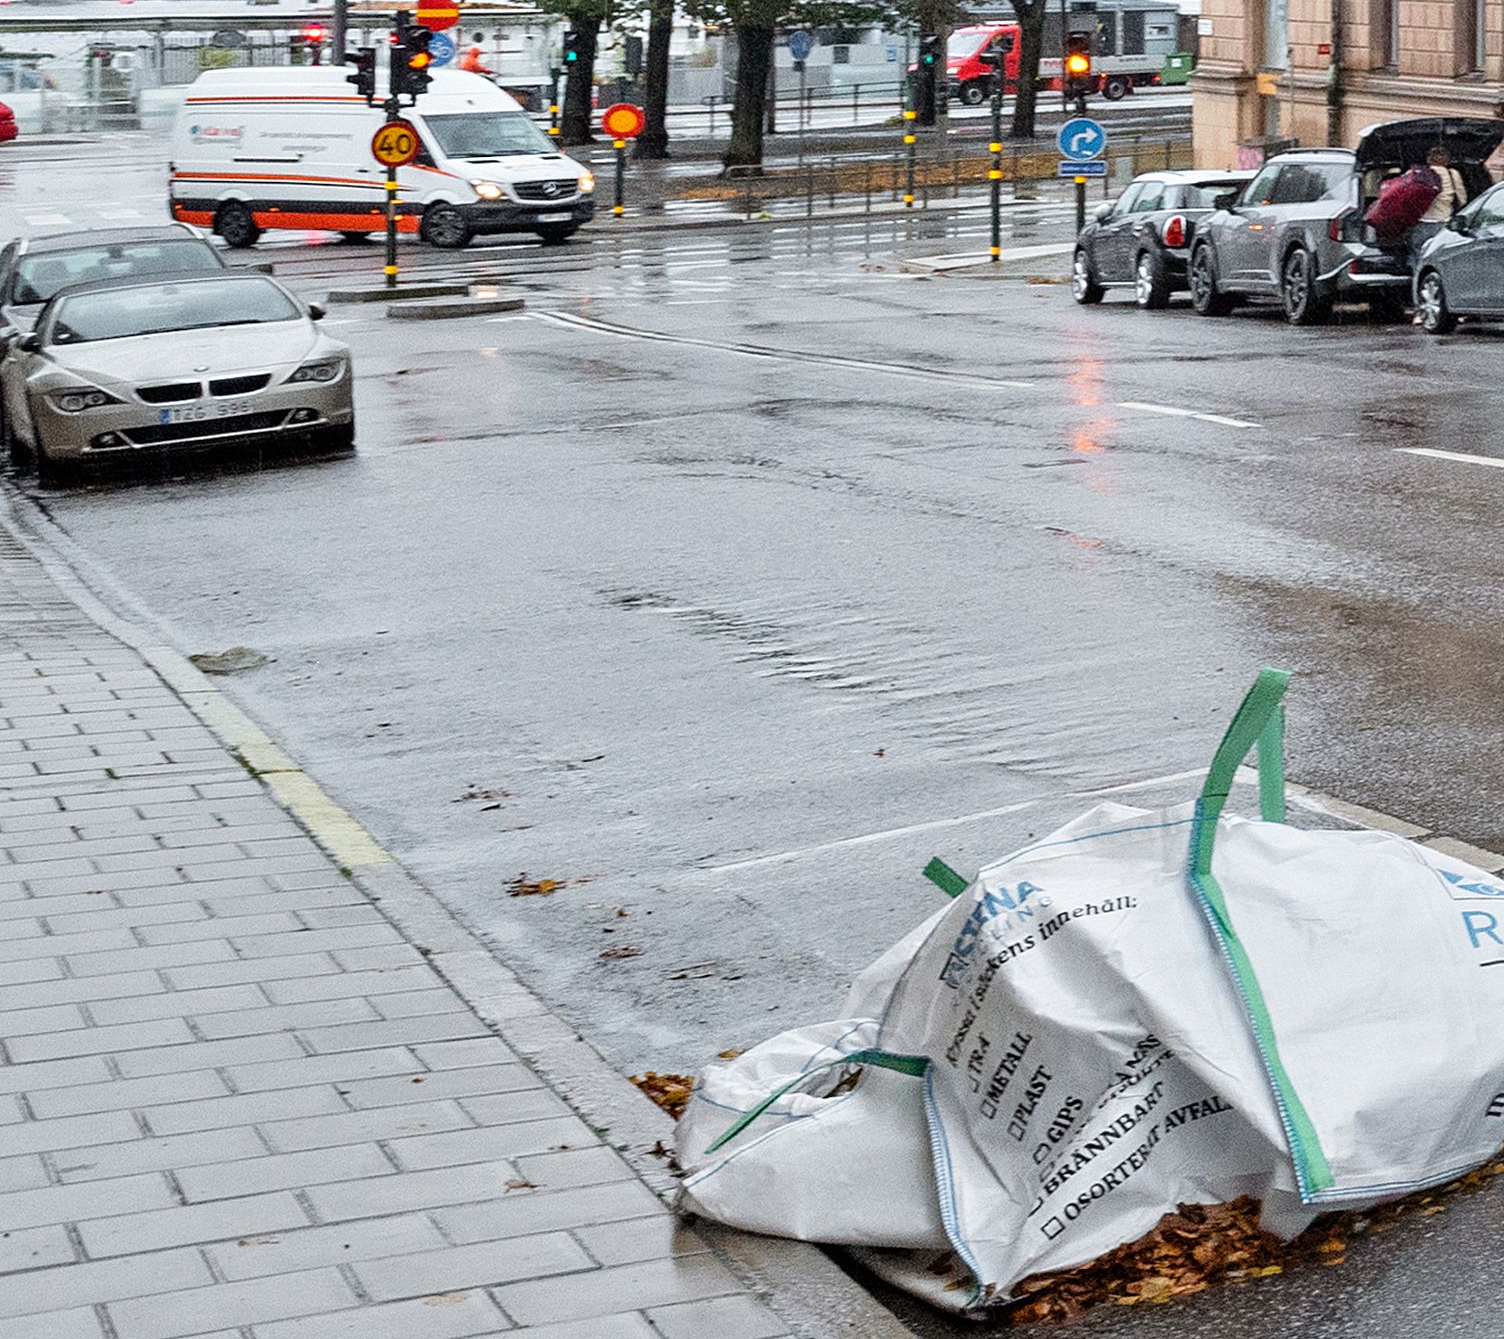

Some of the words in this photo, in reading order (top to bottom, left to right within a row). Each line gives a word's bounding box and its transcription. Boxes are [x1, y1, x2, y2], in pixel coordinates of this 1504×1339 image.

[379, 133, 412, 156] 40
[986, 1031, 1033, 1104] METALL
[1012, 1064, 1053, 1127] PLAST
[1046, 1095, 1085, 1144] GIPS
